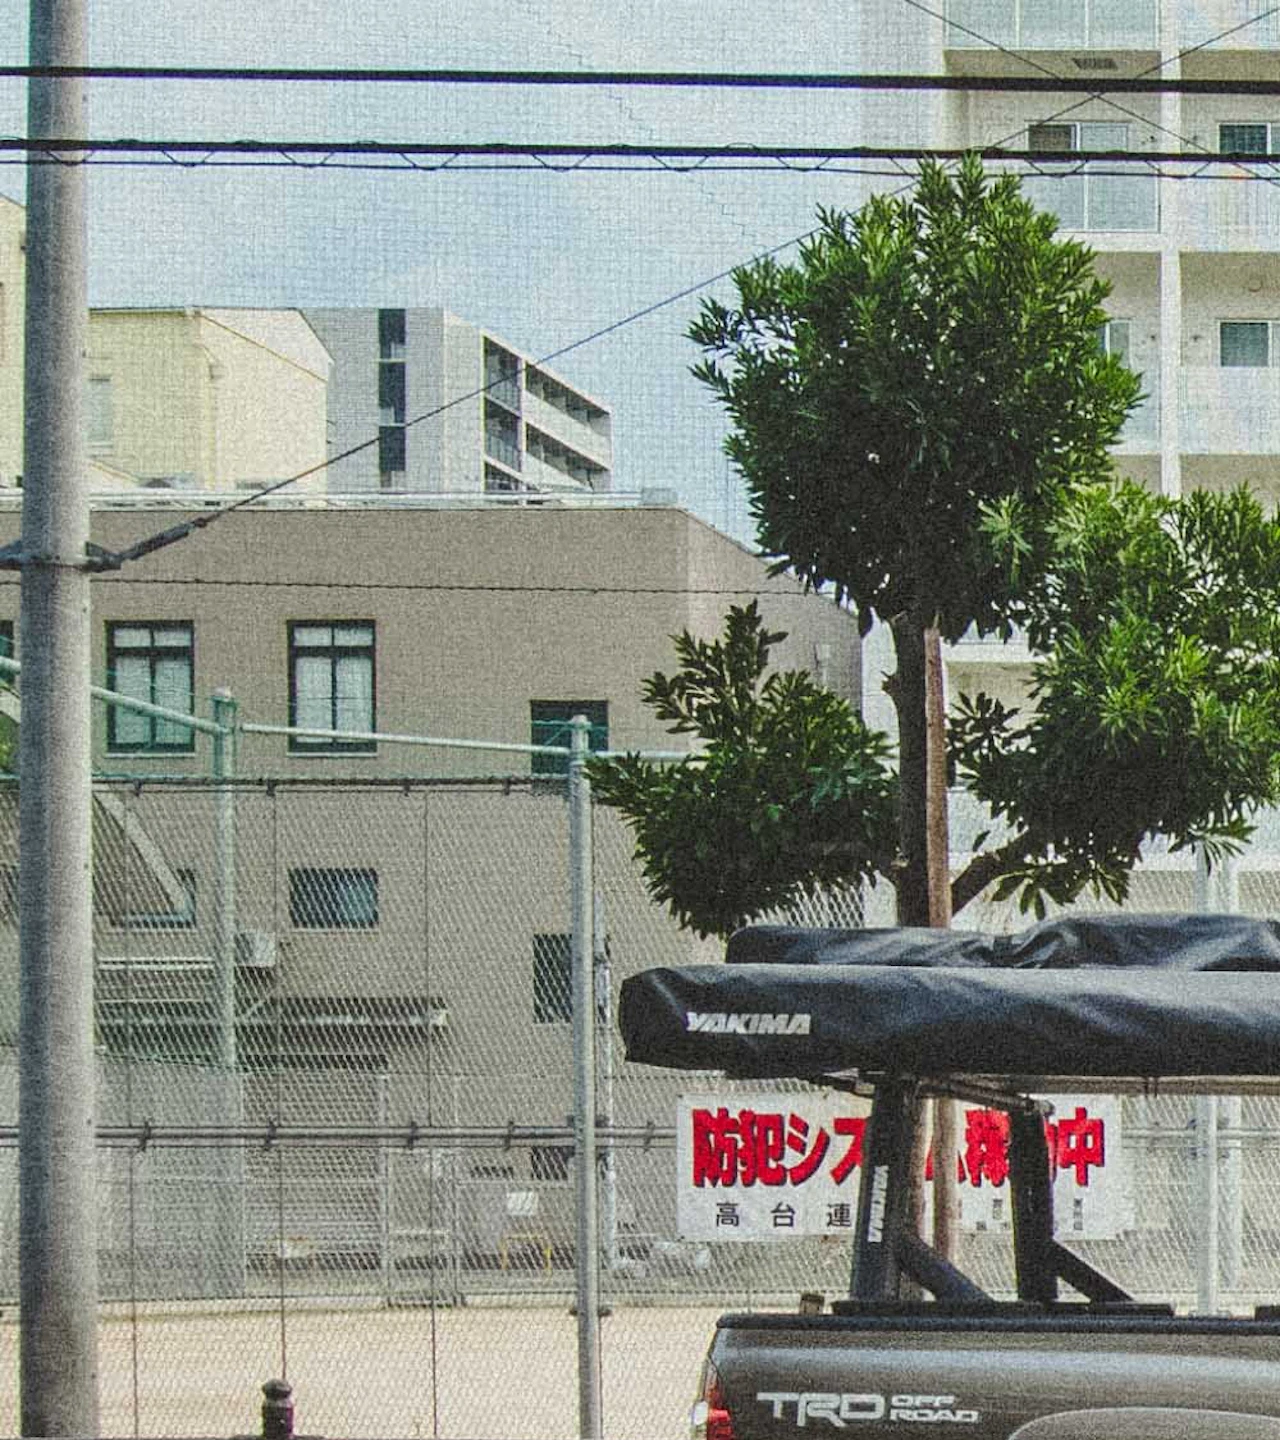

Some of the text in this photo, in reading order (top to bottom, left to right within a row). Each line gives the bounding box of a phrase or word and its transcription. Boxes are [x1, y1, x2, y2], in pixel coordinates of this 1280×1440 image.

[686, 1012, 811, 1034] YAKIMA
[757, 1392, 885, 1427] TRD
[890, 1394, 955, 1407] OFF
[889, 1409, 979, 1423] ROAD
